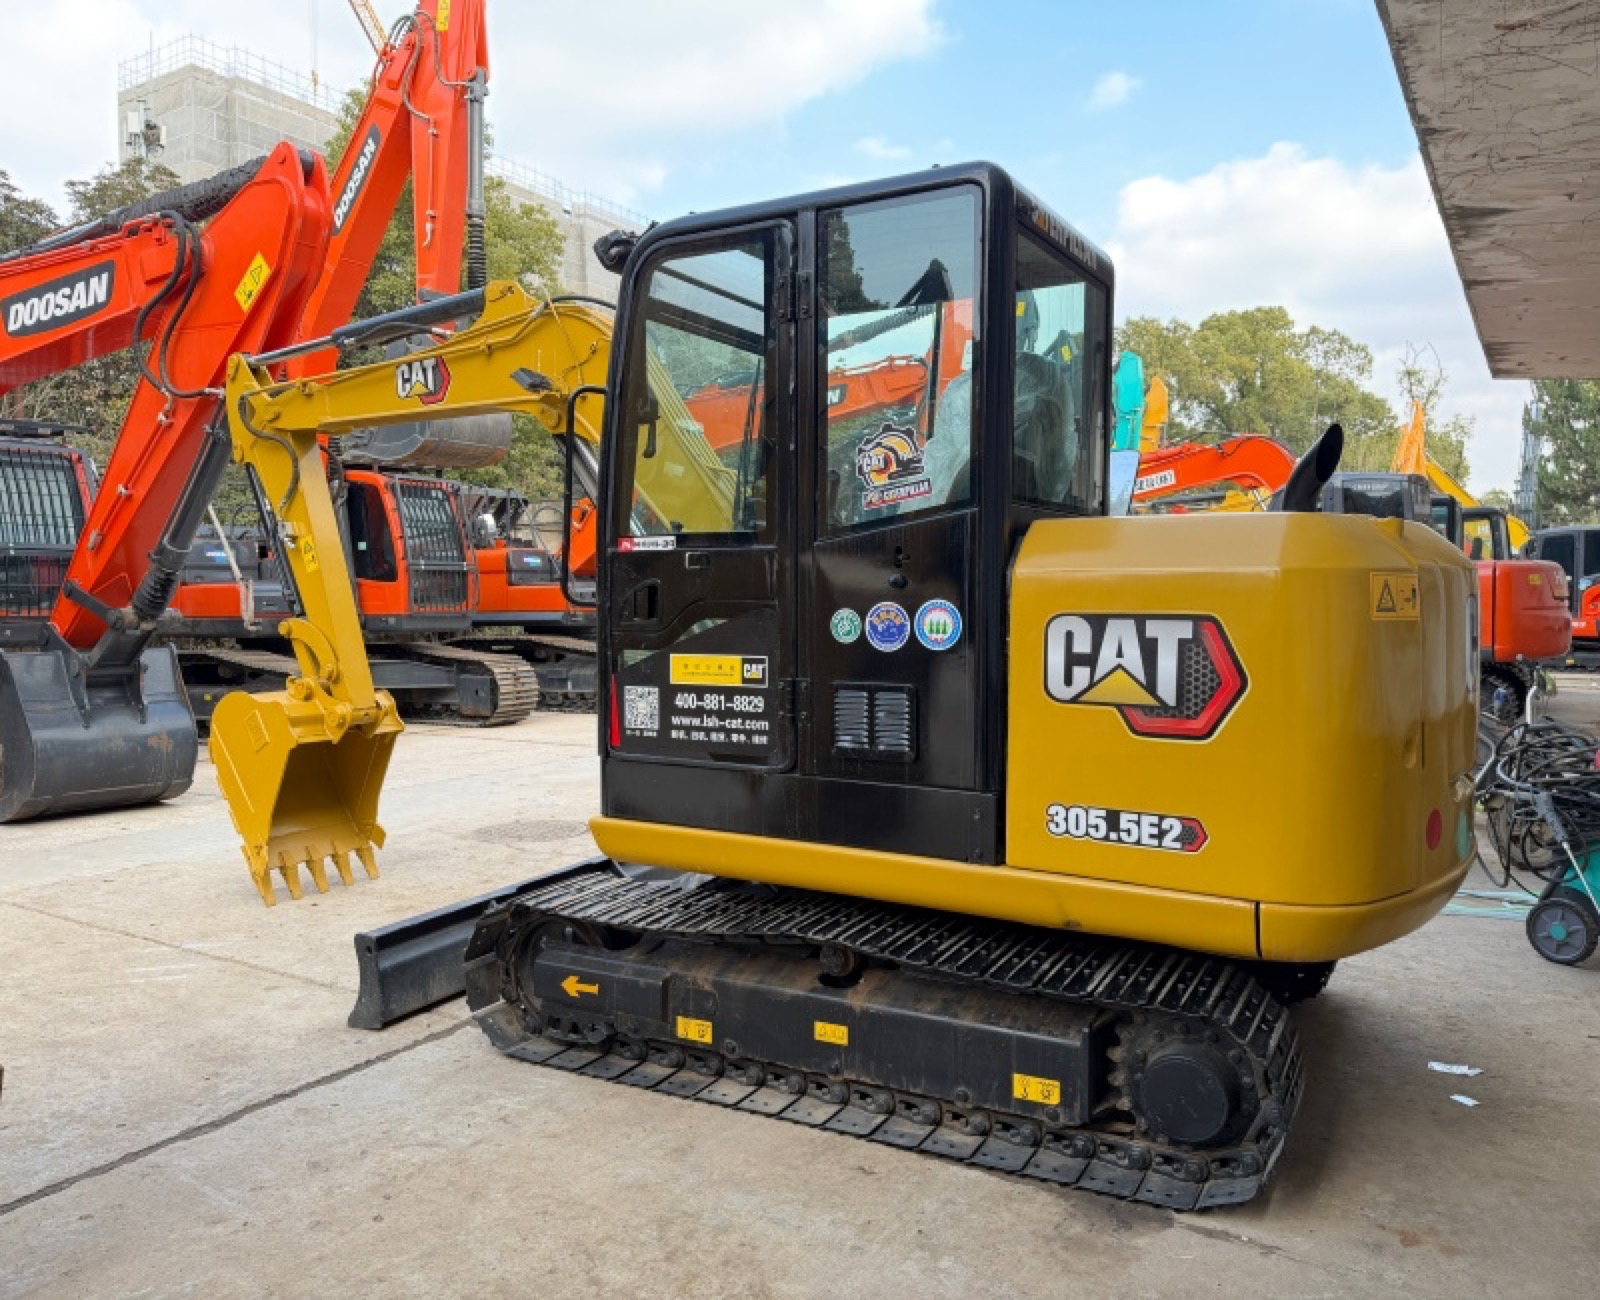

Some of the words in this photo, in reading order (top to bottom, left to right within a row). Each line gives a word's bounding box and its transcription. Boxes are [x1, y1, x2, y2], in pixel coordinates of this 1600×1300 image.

[334, 137, 376, 229] DOOSAN
[7, 271, 109, 333] DOOSAN
[397, 357, 437, 399] CAT
[744, 663, 766, 678] CAT
[1046, 615, 1193, 707] CAT
[674, 692, 765, 713] 400-881-8829
[1047, 804, 1183, 849] 305.5E2
